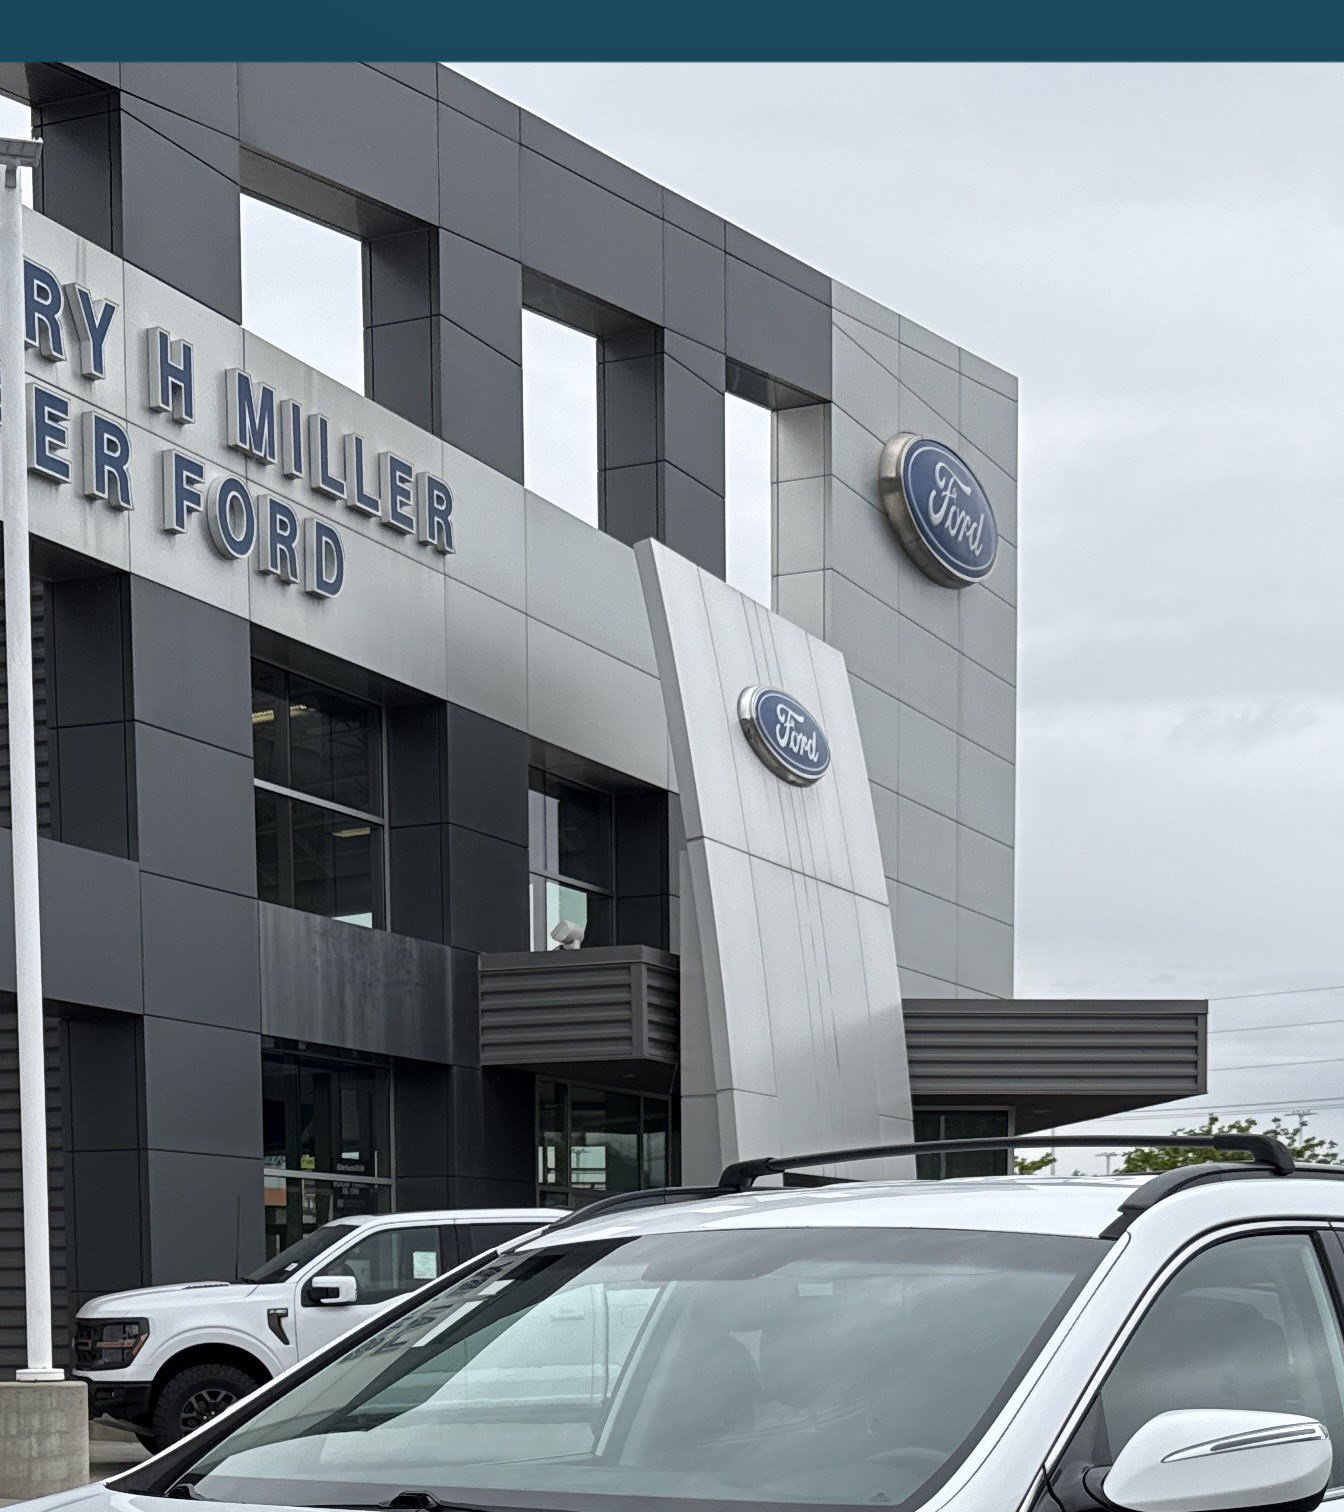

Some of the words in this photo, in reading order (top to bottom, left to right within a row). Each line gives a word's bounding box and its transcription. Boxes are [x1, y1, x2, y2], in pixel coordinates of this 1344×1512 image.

[147, 326, 195, 425] H
[226, 367, 456, 555] MILLER
[163, 448, 346, 600] FORD
[928, 461, 985, 556] Ford
[775, 702, 820, 763] Ford
